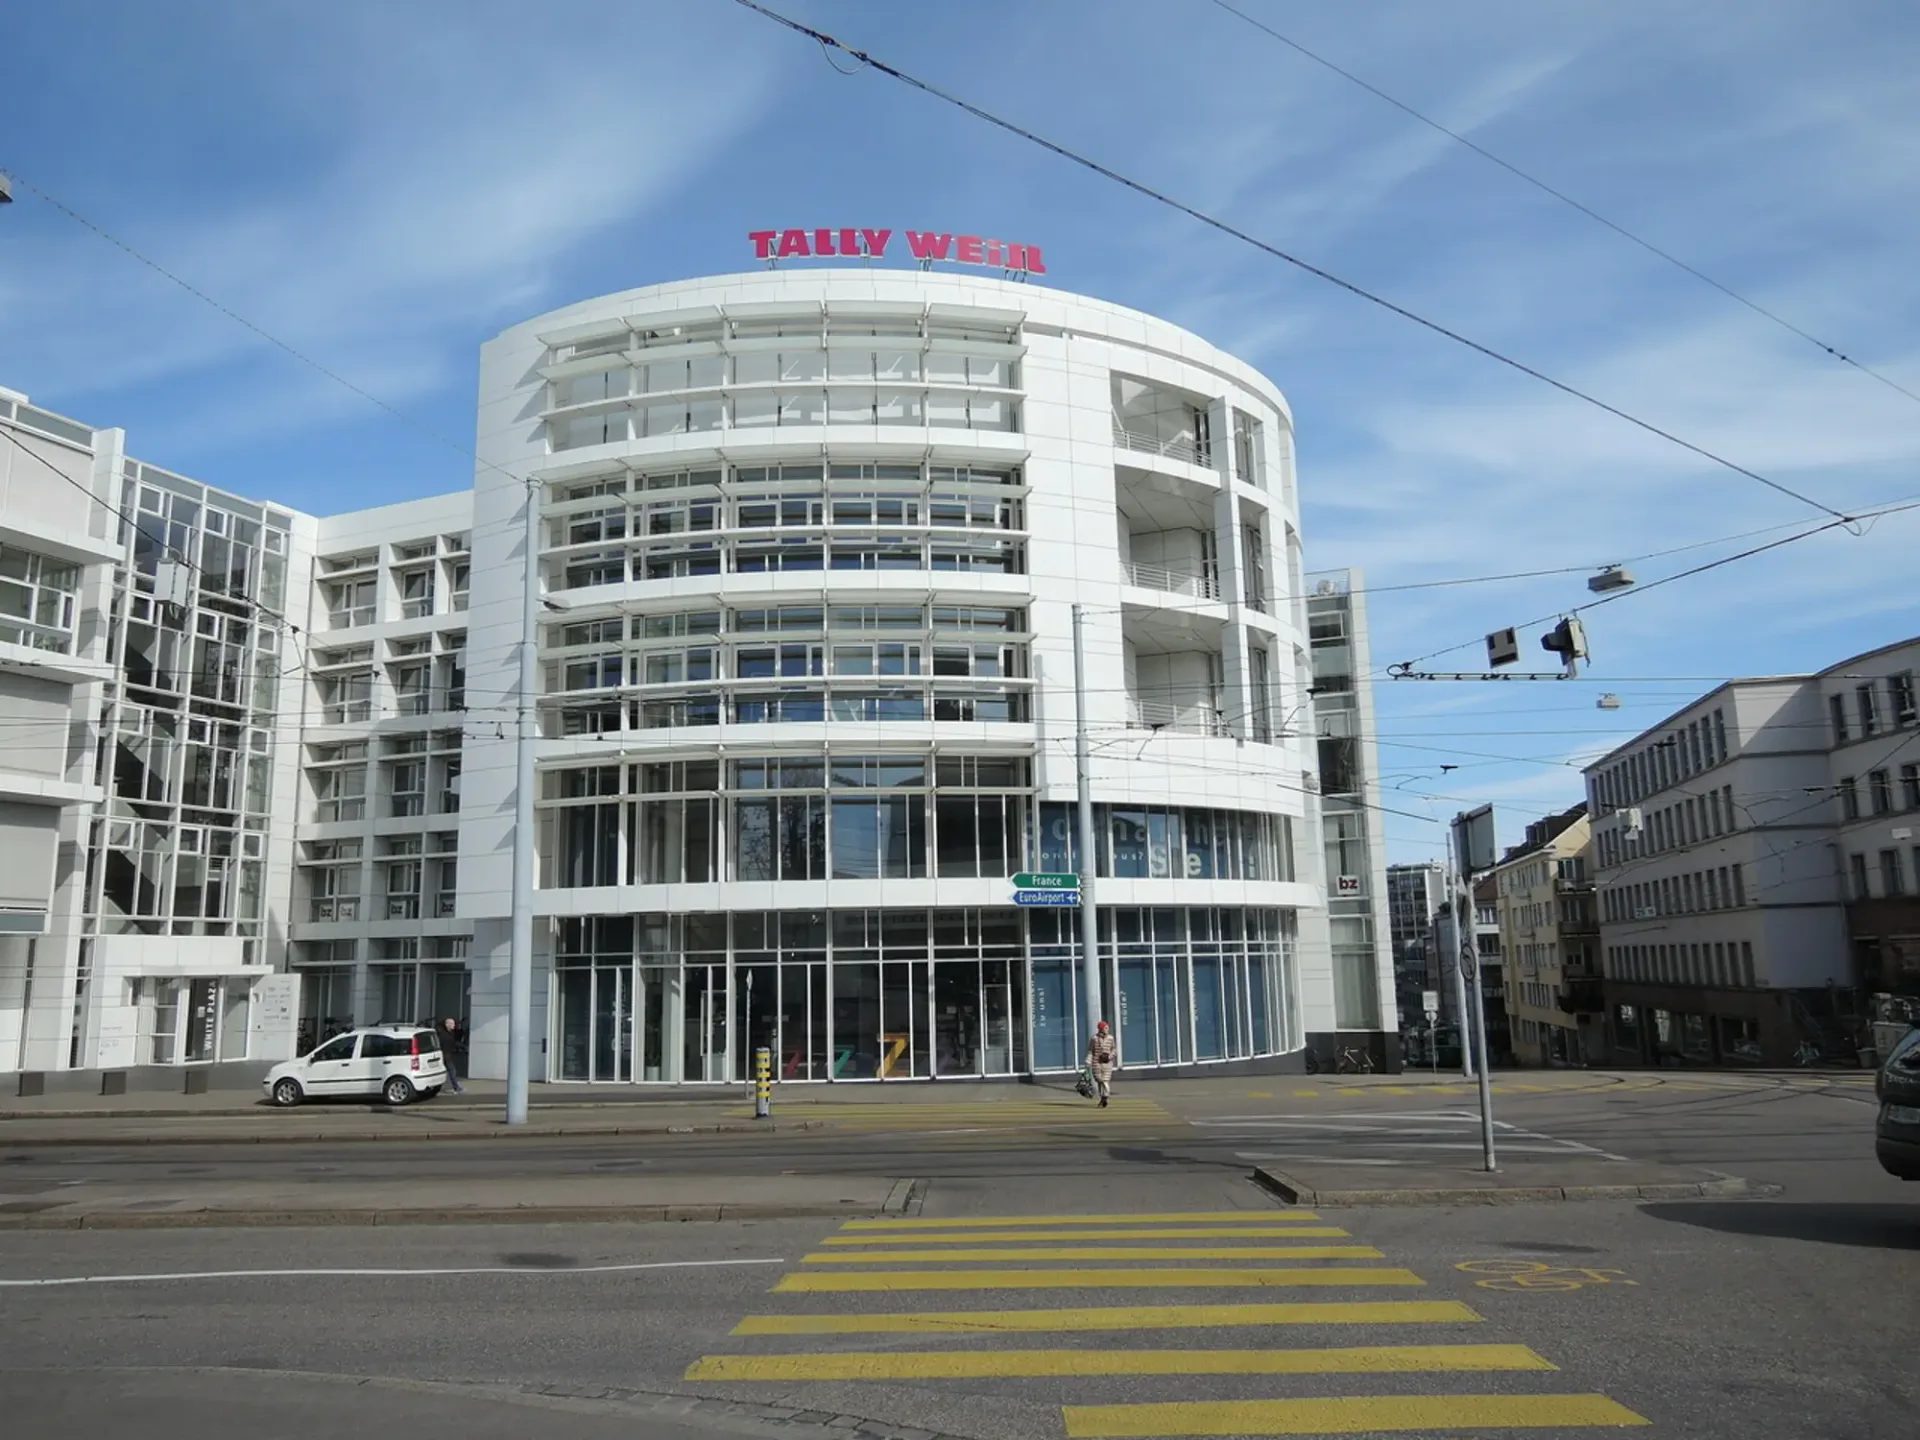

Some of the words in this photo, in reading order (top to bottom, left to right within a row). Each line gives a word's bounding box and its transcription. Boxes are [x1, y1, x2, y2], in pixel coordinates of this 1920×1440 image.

[749, 228, 892, 258] TALLY
[1032, 875, 1062, 886] France
[1338, 877, 1359, 891] bz
[1019, 891, 1065, 905] EuroAirport
[206, 981, 217, 1013] PLAZA
[204, 1018, 214, 1051] WHITE
